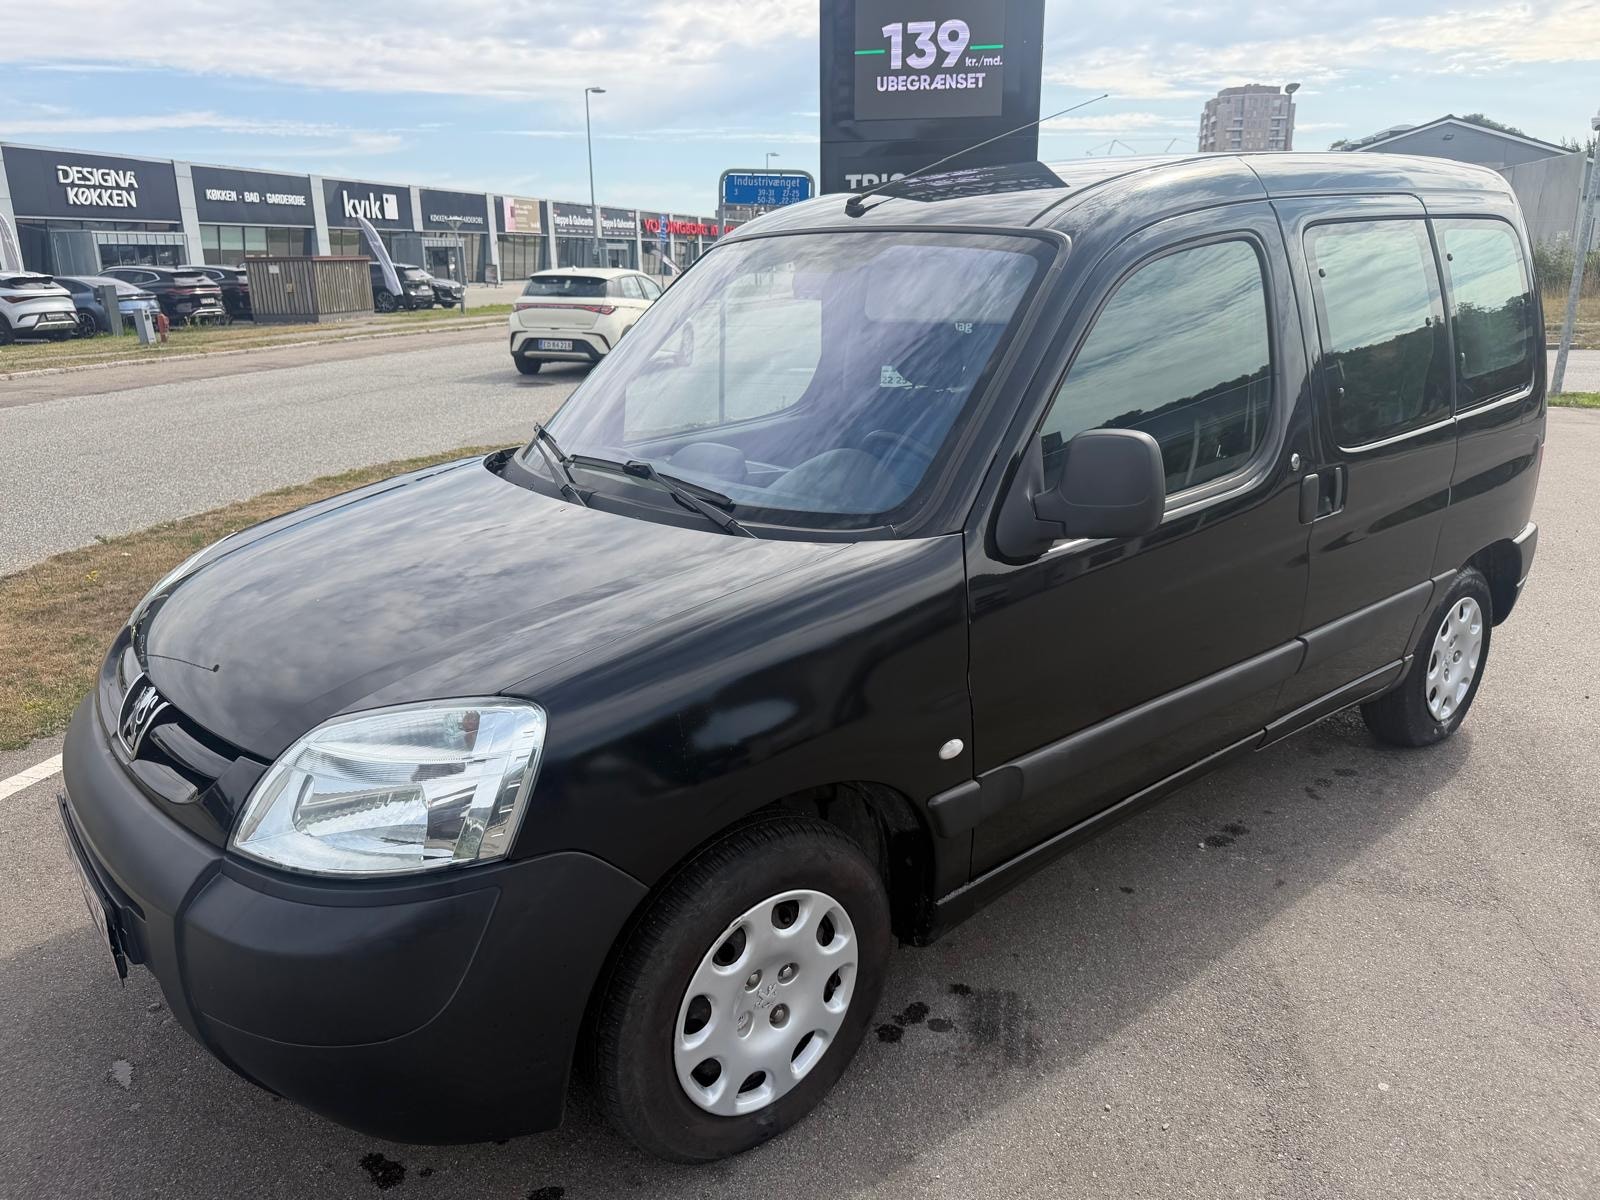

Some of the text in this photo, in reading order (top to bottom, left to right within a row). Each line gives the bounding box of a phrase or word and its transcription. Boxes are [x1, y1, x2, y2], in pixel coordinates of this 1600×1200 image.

[881, 19, 971, 70] 139
[965, 55, 1003, 67] kr./md.
[876, 72, 986, 92] UBEGRÆNSET
[56, 164, 138, 189] DESIGNA
[733, 175, 800, 190] Industrivænget
[66, 186, 137, 208] KØKKEN
[205, 188, 306, 206] KØKKEN BAD GARDEROBE
